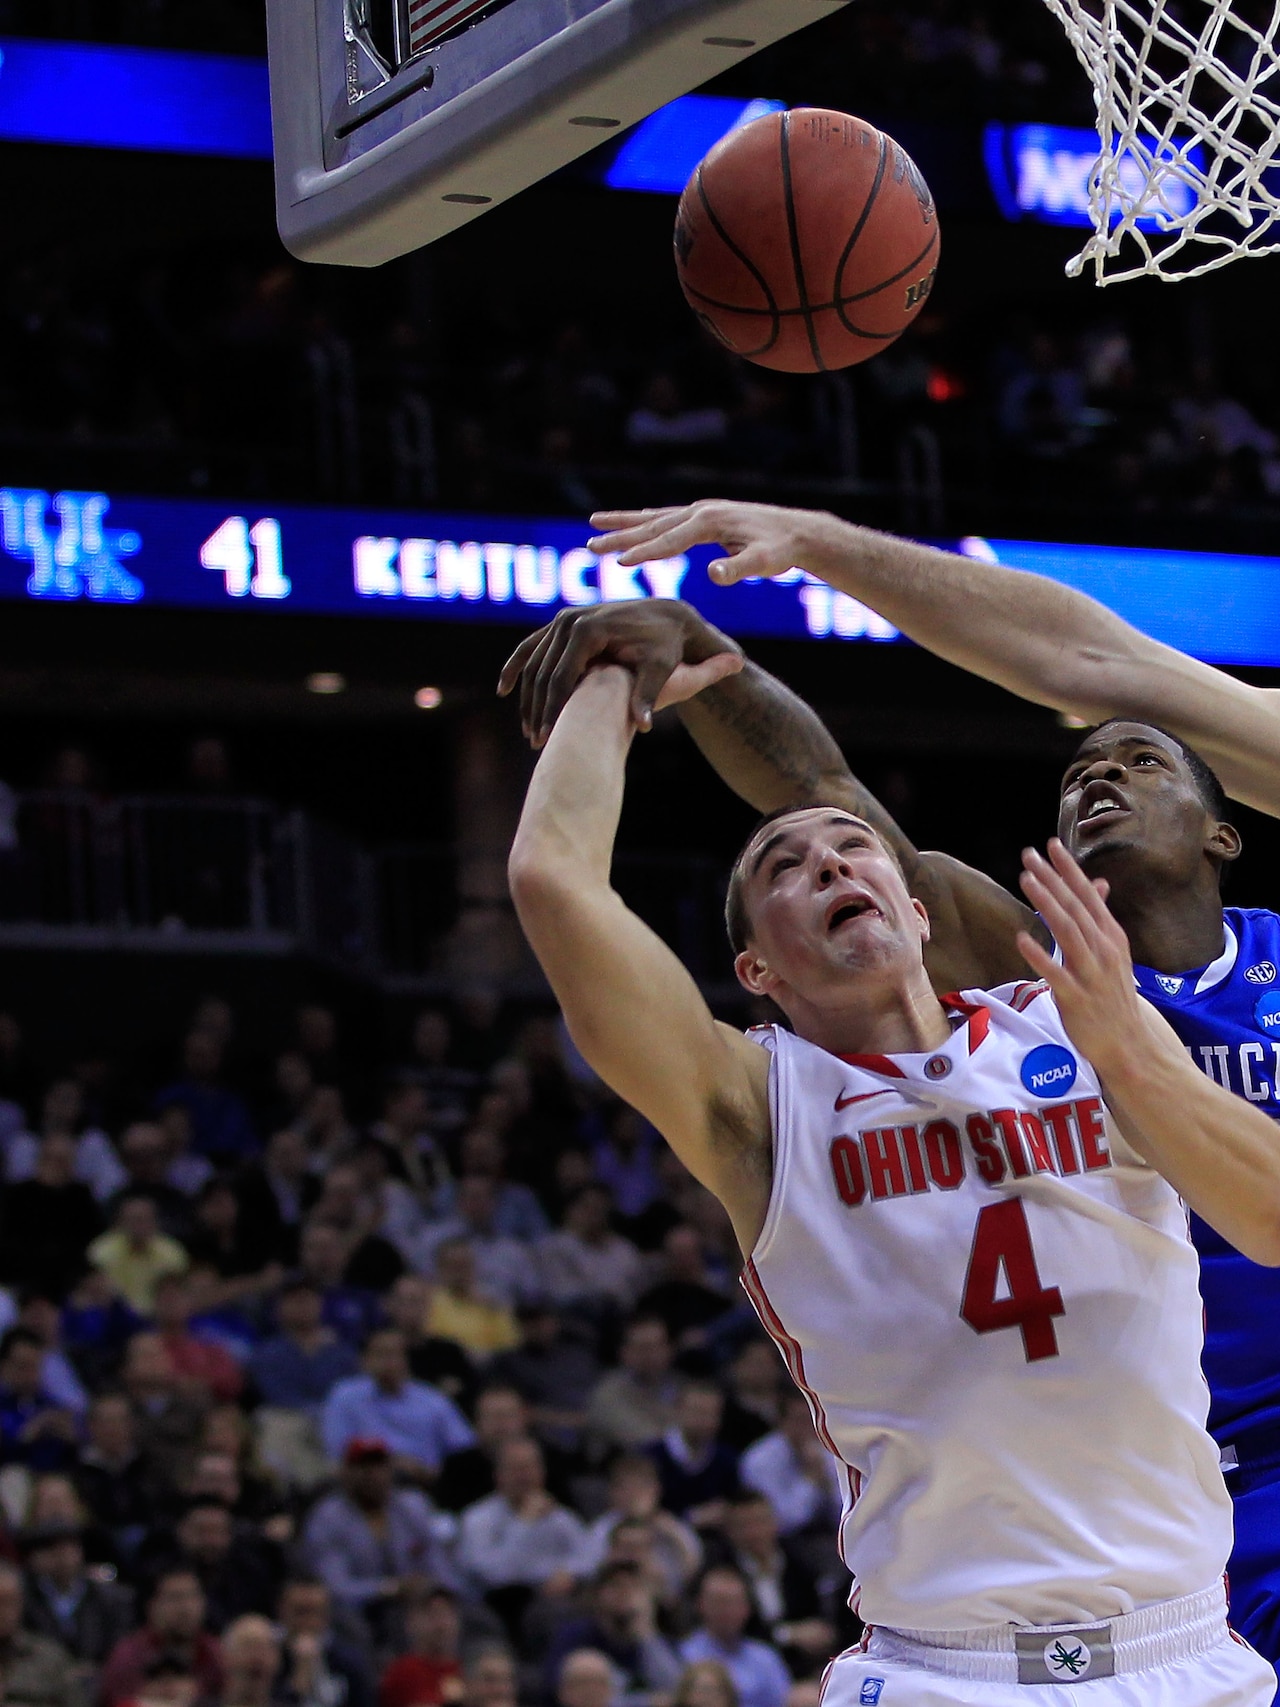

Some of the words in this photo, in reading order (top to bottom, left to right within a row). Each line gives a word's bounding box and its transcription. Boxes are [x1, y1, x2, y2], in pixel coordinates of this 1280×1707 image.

[200, 516, 291, 599] 41
[354, 534, 690, 605] KENTUCKY
[1247, 962, 1276, 984] SEC
[1031, 1064, 1072, 1088] NCAA
[829, 1118, 967, 1209] OHIO
[965, 1097, 1113, 1188] STATE
[959, 1196, 1066, 1363] 4
